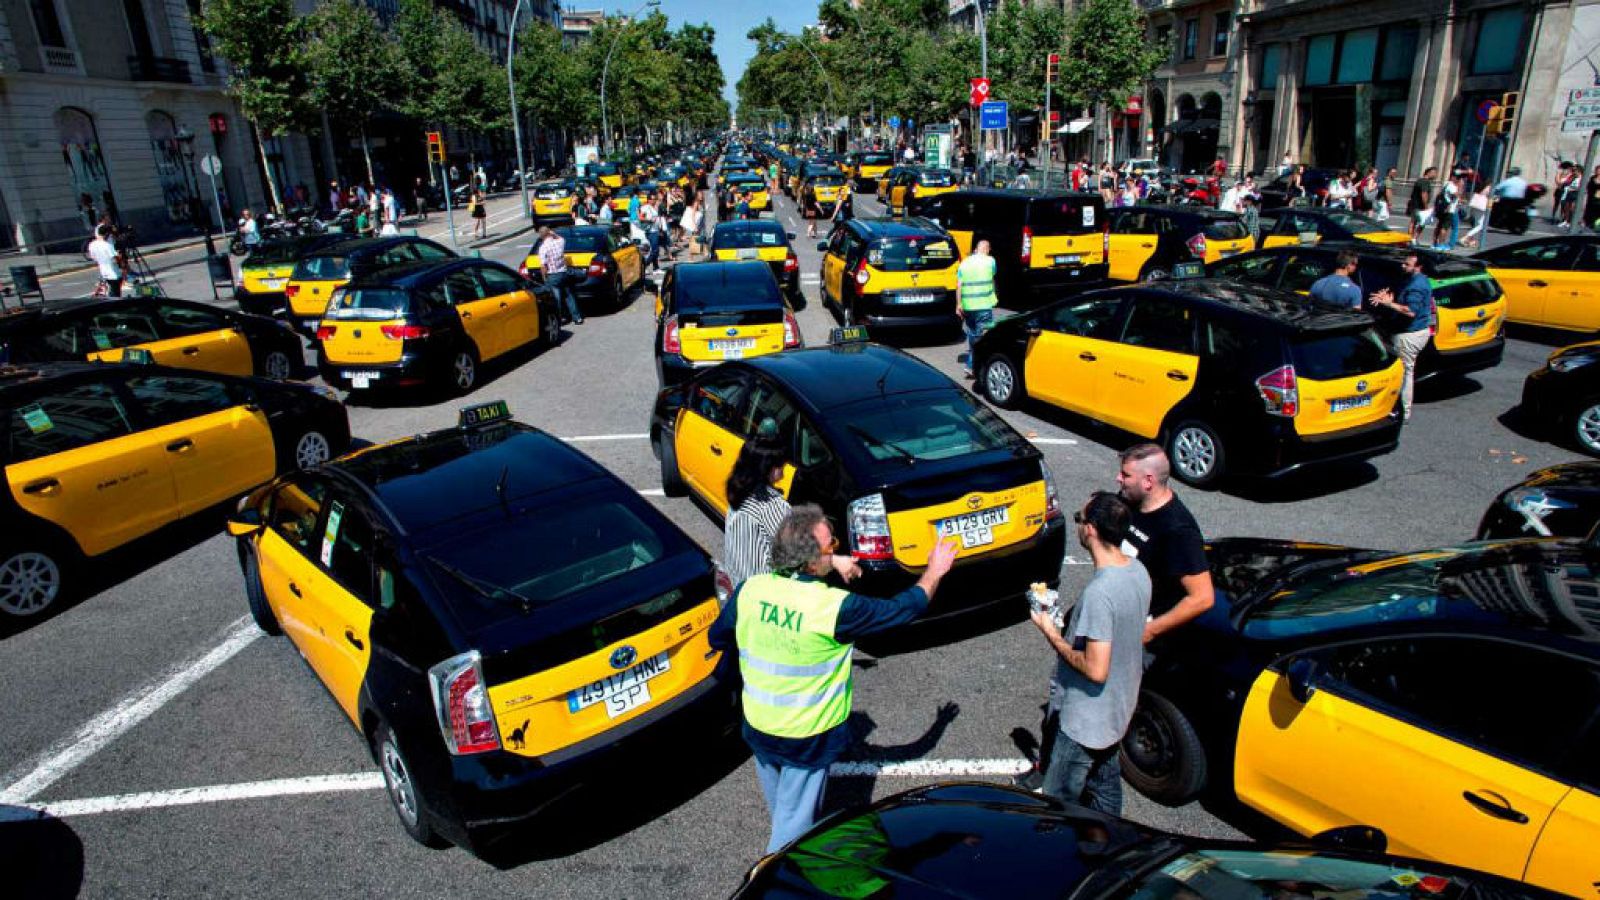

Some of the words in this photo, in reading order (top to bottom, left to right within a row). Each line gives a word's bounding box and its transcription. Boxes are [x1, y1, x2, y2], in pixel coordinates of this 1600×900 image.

[843, 328, 860, 339] TAXI
[477, 404, 500, 421] TAXI
[982, 509, 1005, 526] GRV
[965, 528, 988, 546] SP
[759, 601, 803, 632] TAXI
[582, 675, 627, 703] 4917
[633, 656, 667, 682] HNL
[612, 686, 642, 712] SP
